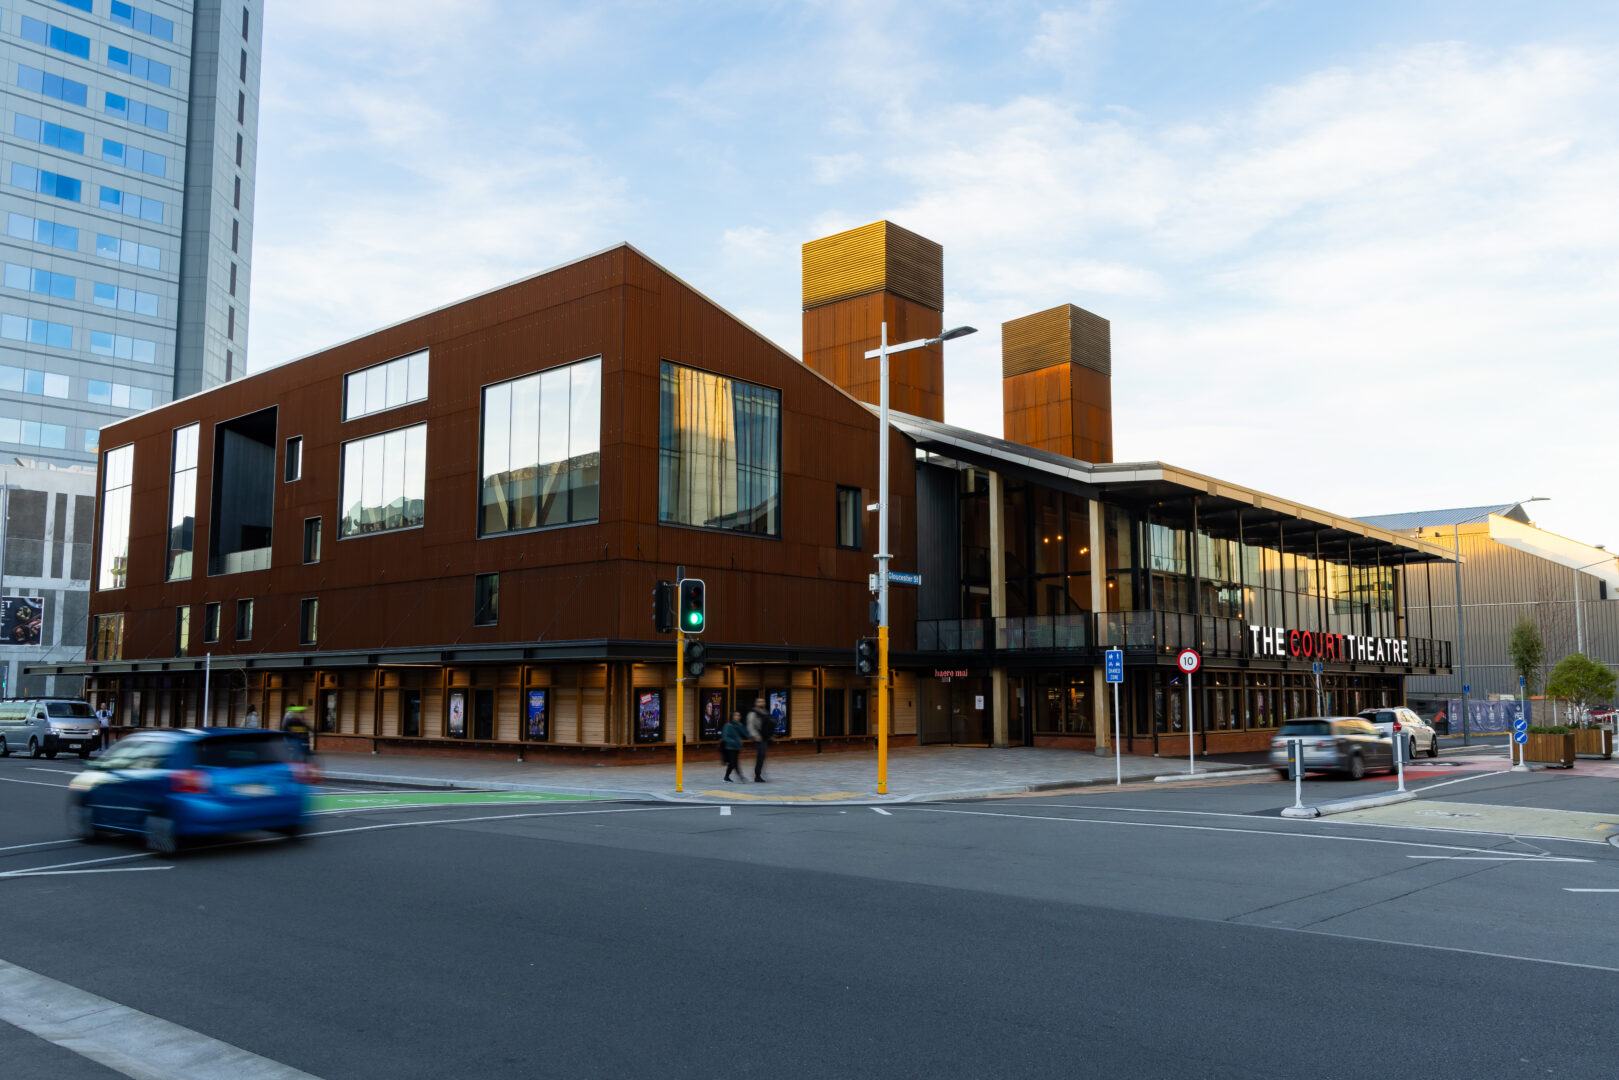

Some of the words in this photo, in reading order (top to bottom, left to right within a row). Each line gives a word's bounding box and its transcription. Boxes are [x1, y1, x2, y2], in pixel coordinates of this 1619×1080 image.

[888, 572, 912, 582] Gloucester
[1249, 625, 1286, 655] THE
[1290, 629, 1343, 660] COURT
[1347, 634, 1409, 663] THEATRE
[1183, 657, 1193, 665] 10
[935, 668, 954, 677] haere
